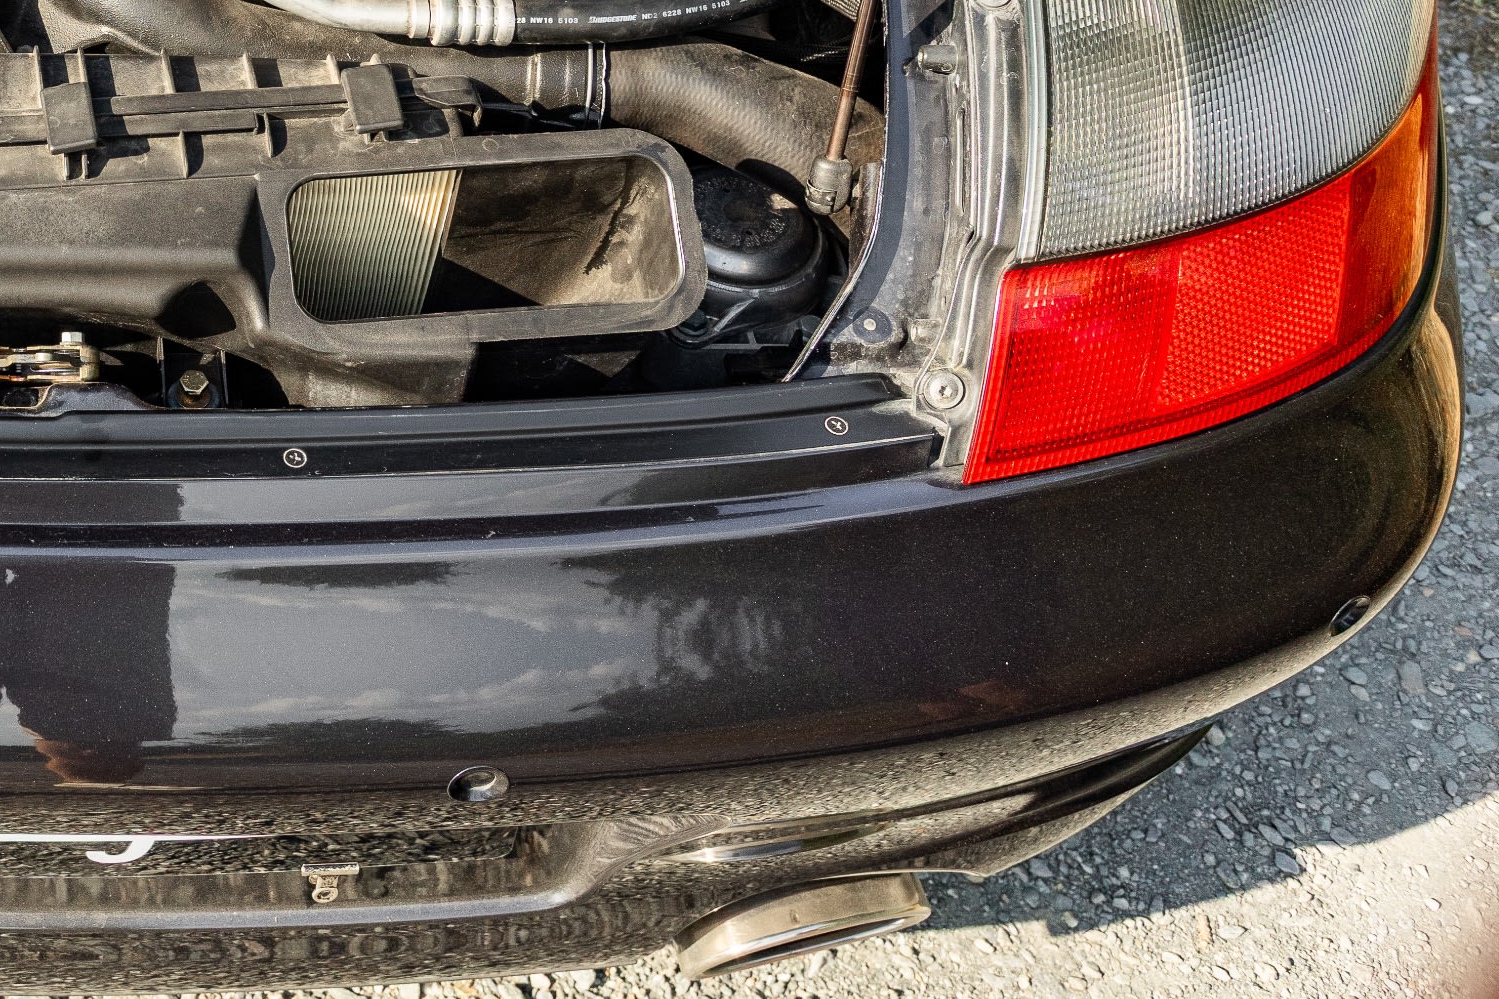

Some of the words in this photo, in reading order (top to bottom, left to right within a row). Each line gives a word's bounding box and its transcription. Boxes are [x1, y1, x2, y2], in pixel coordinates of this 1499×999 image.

[662, 8, 682, 18] 6228
[685, 4, 708, 15] NW16
[711, 0, 731, 9] 5103
